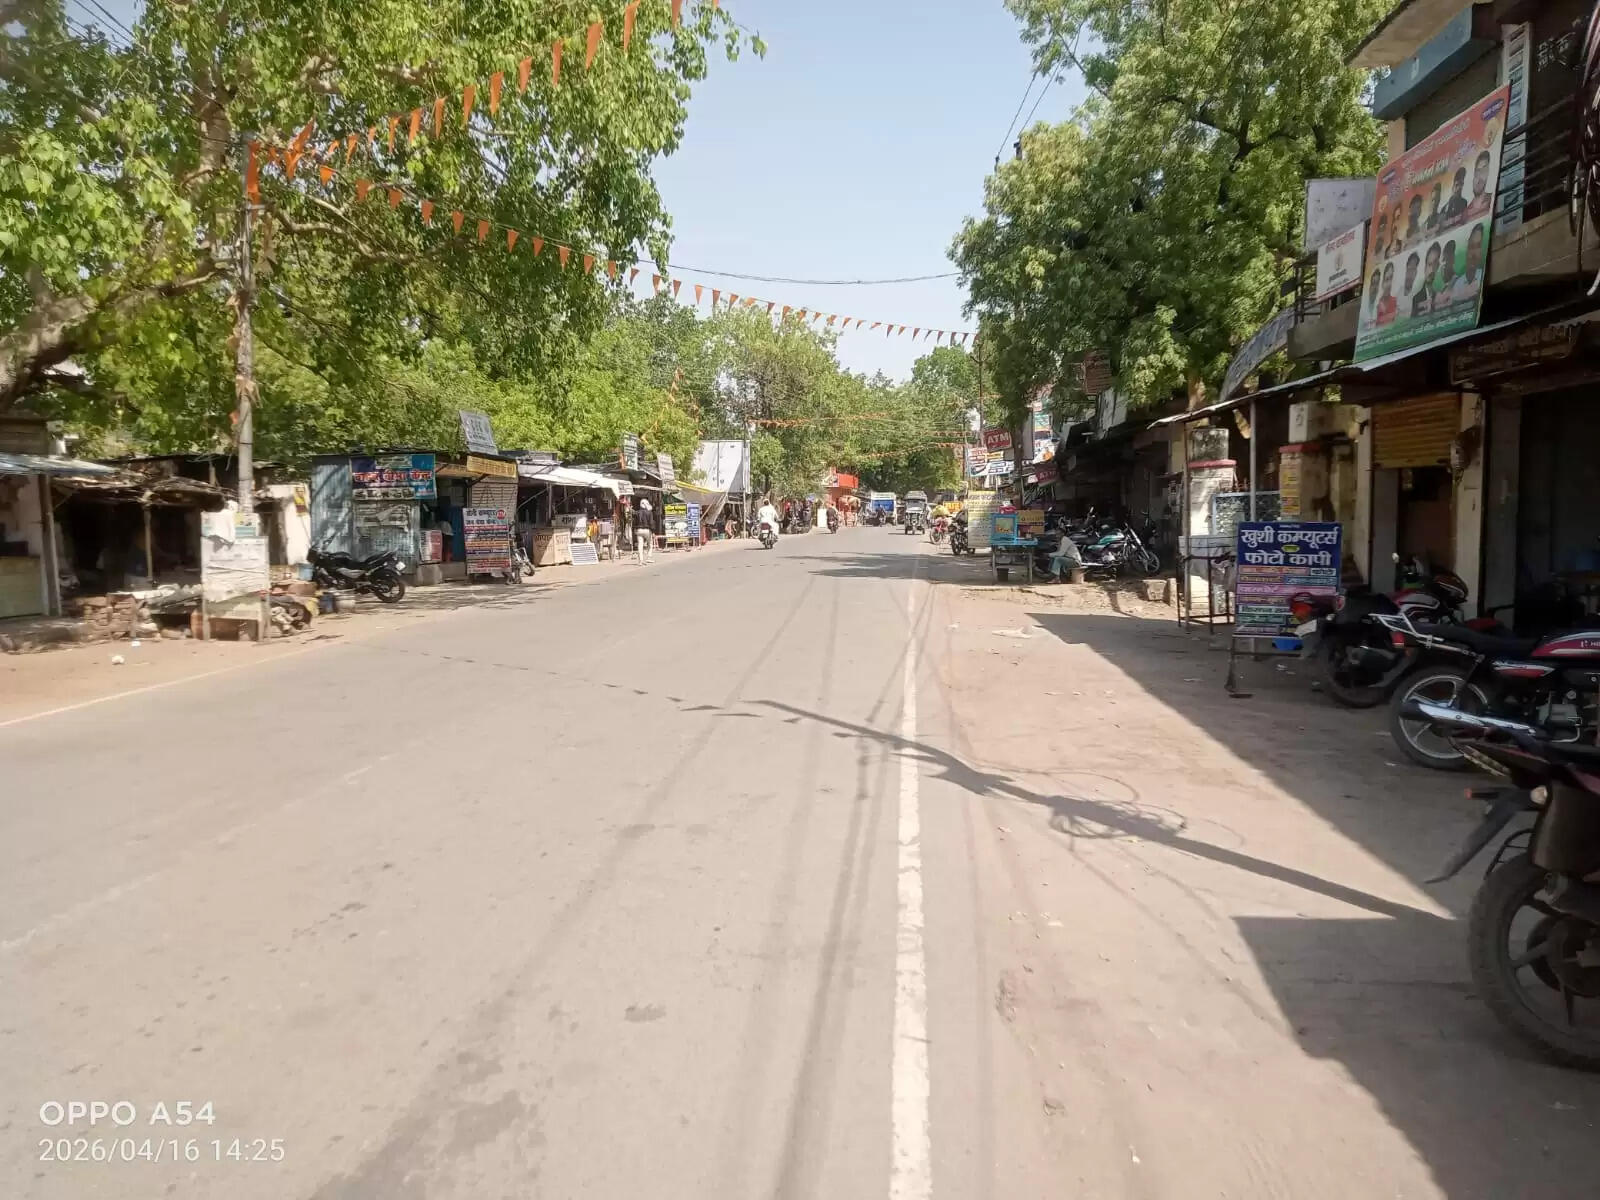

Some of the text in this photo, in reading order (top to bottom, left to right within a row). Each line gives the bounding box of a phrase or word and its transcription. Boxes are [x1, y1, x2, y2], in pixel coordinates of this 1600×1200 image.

[988, 433, 1009, 443] ATM
[1241, 526, 1338, 549] खुशी कम्प्यूटर्स
[1245, 550, 1331, 566] फोटो कापी
